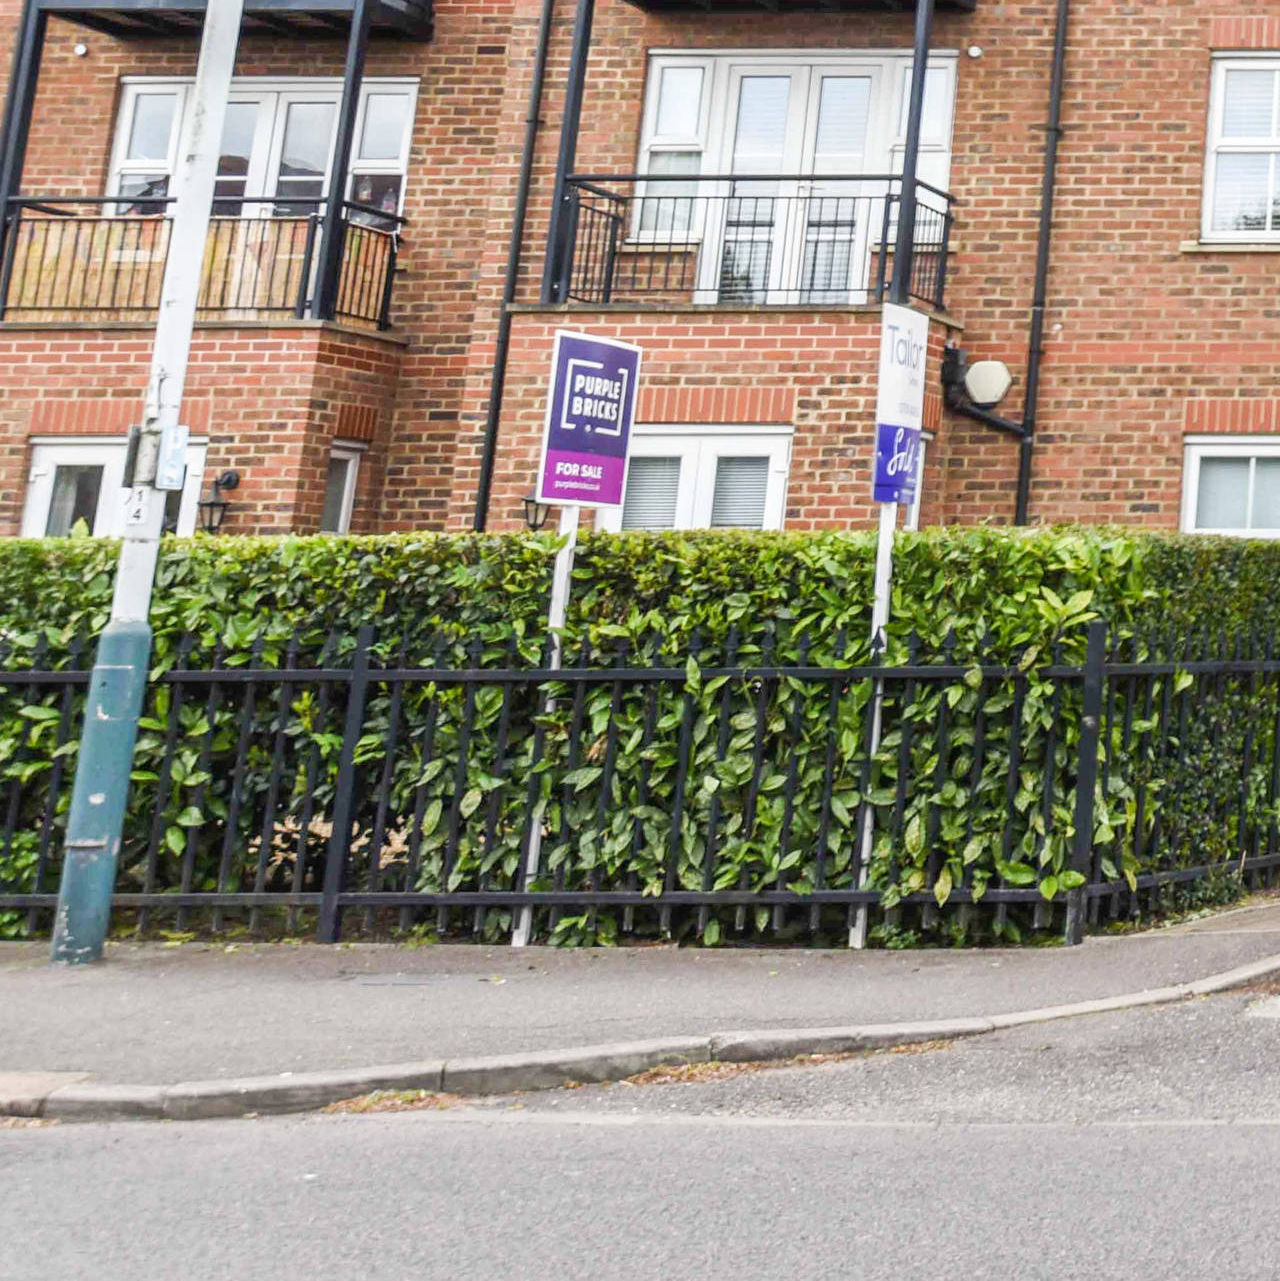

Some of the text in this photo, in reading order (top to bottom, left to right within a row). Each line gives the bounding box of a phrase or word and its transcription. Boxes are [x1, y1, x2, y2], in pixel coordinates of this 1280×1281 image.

[887, 324, 923, 371] Tailor
[574, 374, 621, 400] PURPLE
[572, 396, 618, 421] BRICKS
[555, 461, 603, 479] FOR SALE
